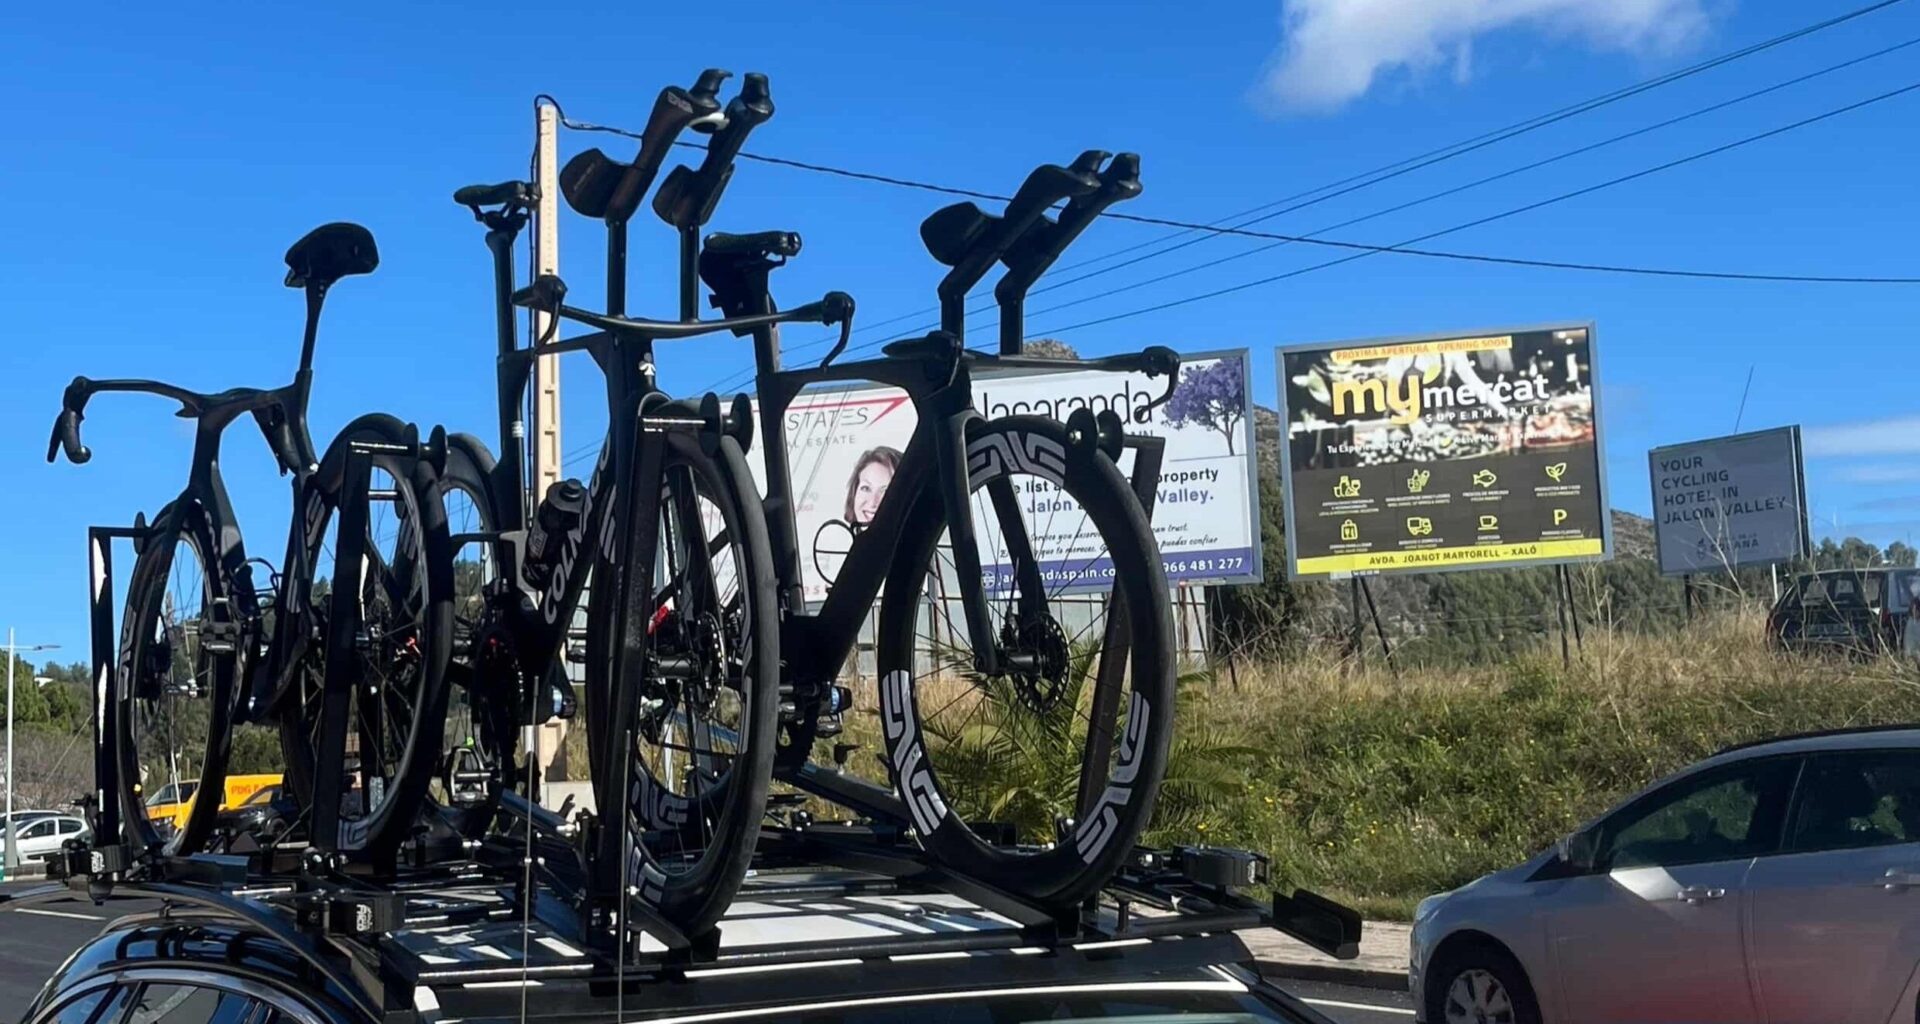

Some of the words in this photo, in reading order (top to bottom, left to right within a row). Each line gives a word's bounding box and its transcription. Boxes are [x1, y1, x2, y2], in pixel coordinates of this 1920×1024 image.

[786, 406, 869, 431] STATES
[1425, 404, 1551, 423] SUPERMARKET
[1661, 456, 1703, 472] YOUR
[1662, 470, 1729, 489] CYCLING
[1664, 490, 1716, 506] HOTEL
[1722, 486, 1738, 499] IN
[1027, 499, 1072, 513] Jalon
[1664, 507, 1714, 524] JALON
[1722, 497, 1786, 517] VALLEY
[1190, 559, 1213, 571] 481
[1218, 557, 1243, 569] 277
[1403, 552, 1440, 563] JOANOT
[1443, 550, 1501, 561] MARTORELL
